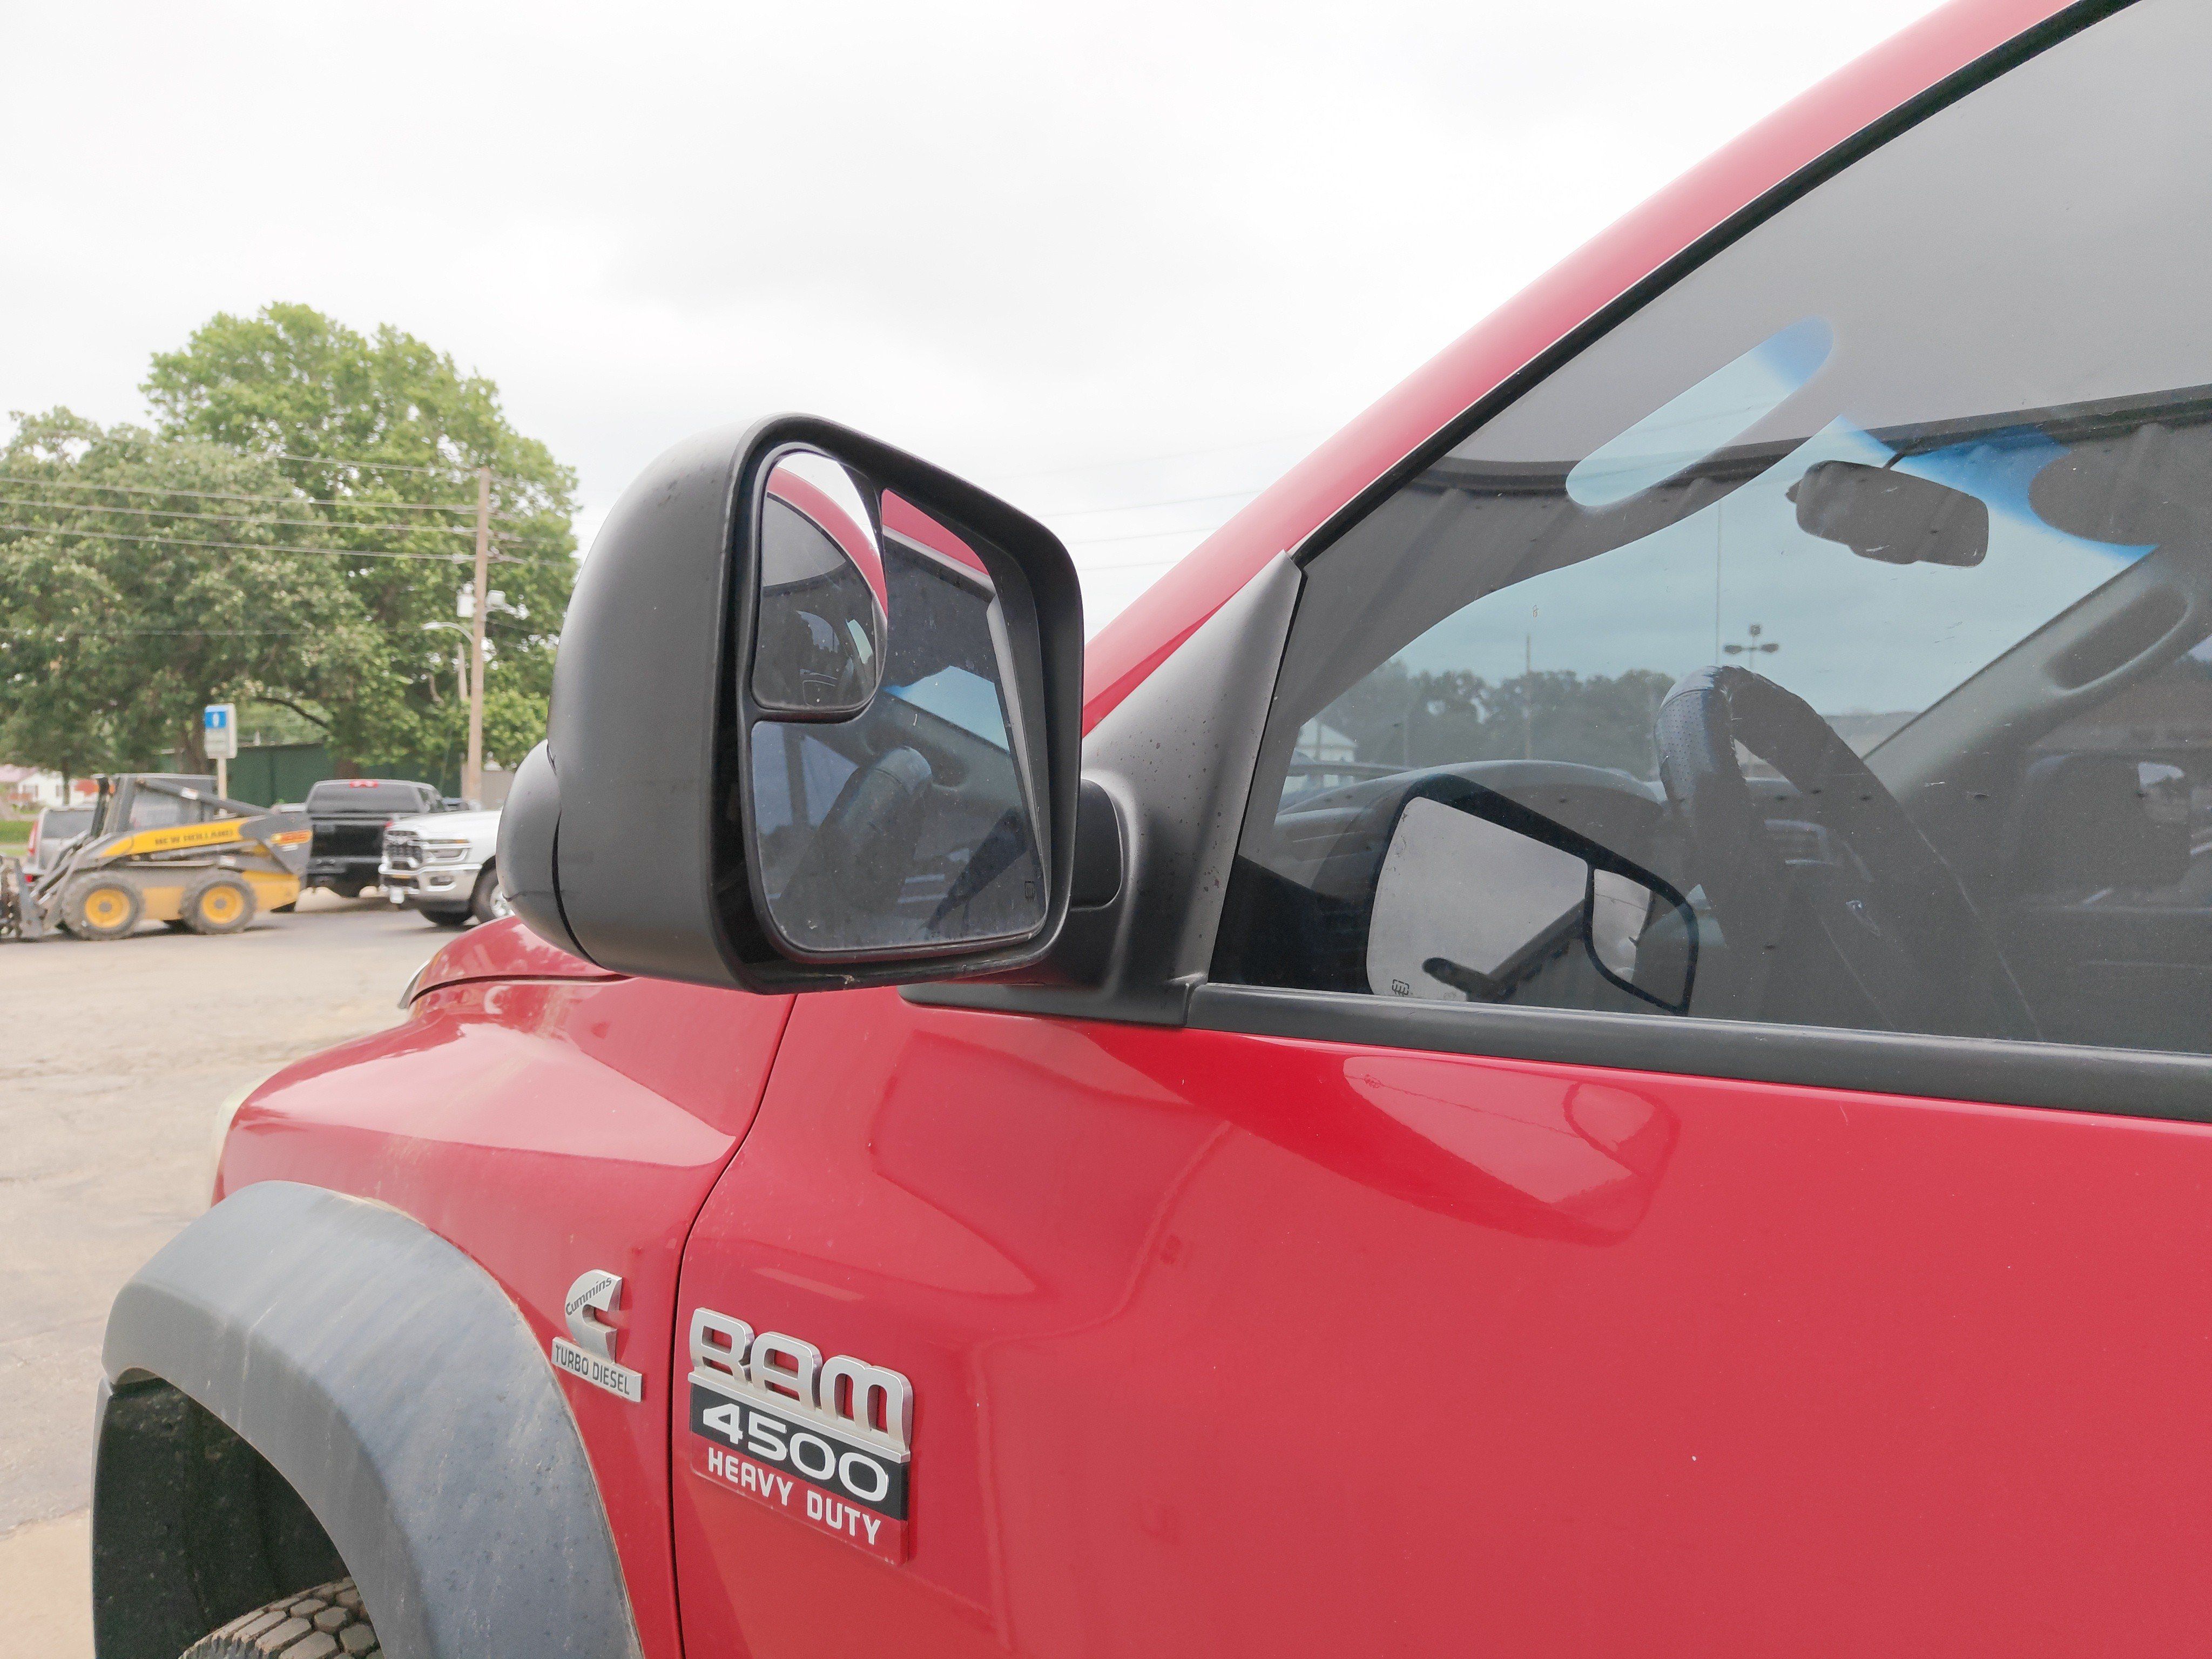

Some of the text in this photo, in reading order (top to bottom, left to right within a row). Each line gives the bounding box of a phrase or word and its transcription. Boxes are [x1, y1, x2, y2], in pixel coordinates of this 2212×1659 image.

[565, 1277, 612, 1316] Cummins
[555, 1344, 630, 1395] TURBO DIESEL
[689, 1307, 914, 1451] RAM
[703, 1403, 889, 1502] 4500
[709, 1447, 881, 1545] HEAVY DUTY
